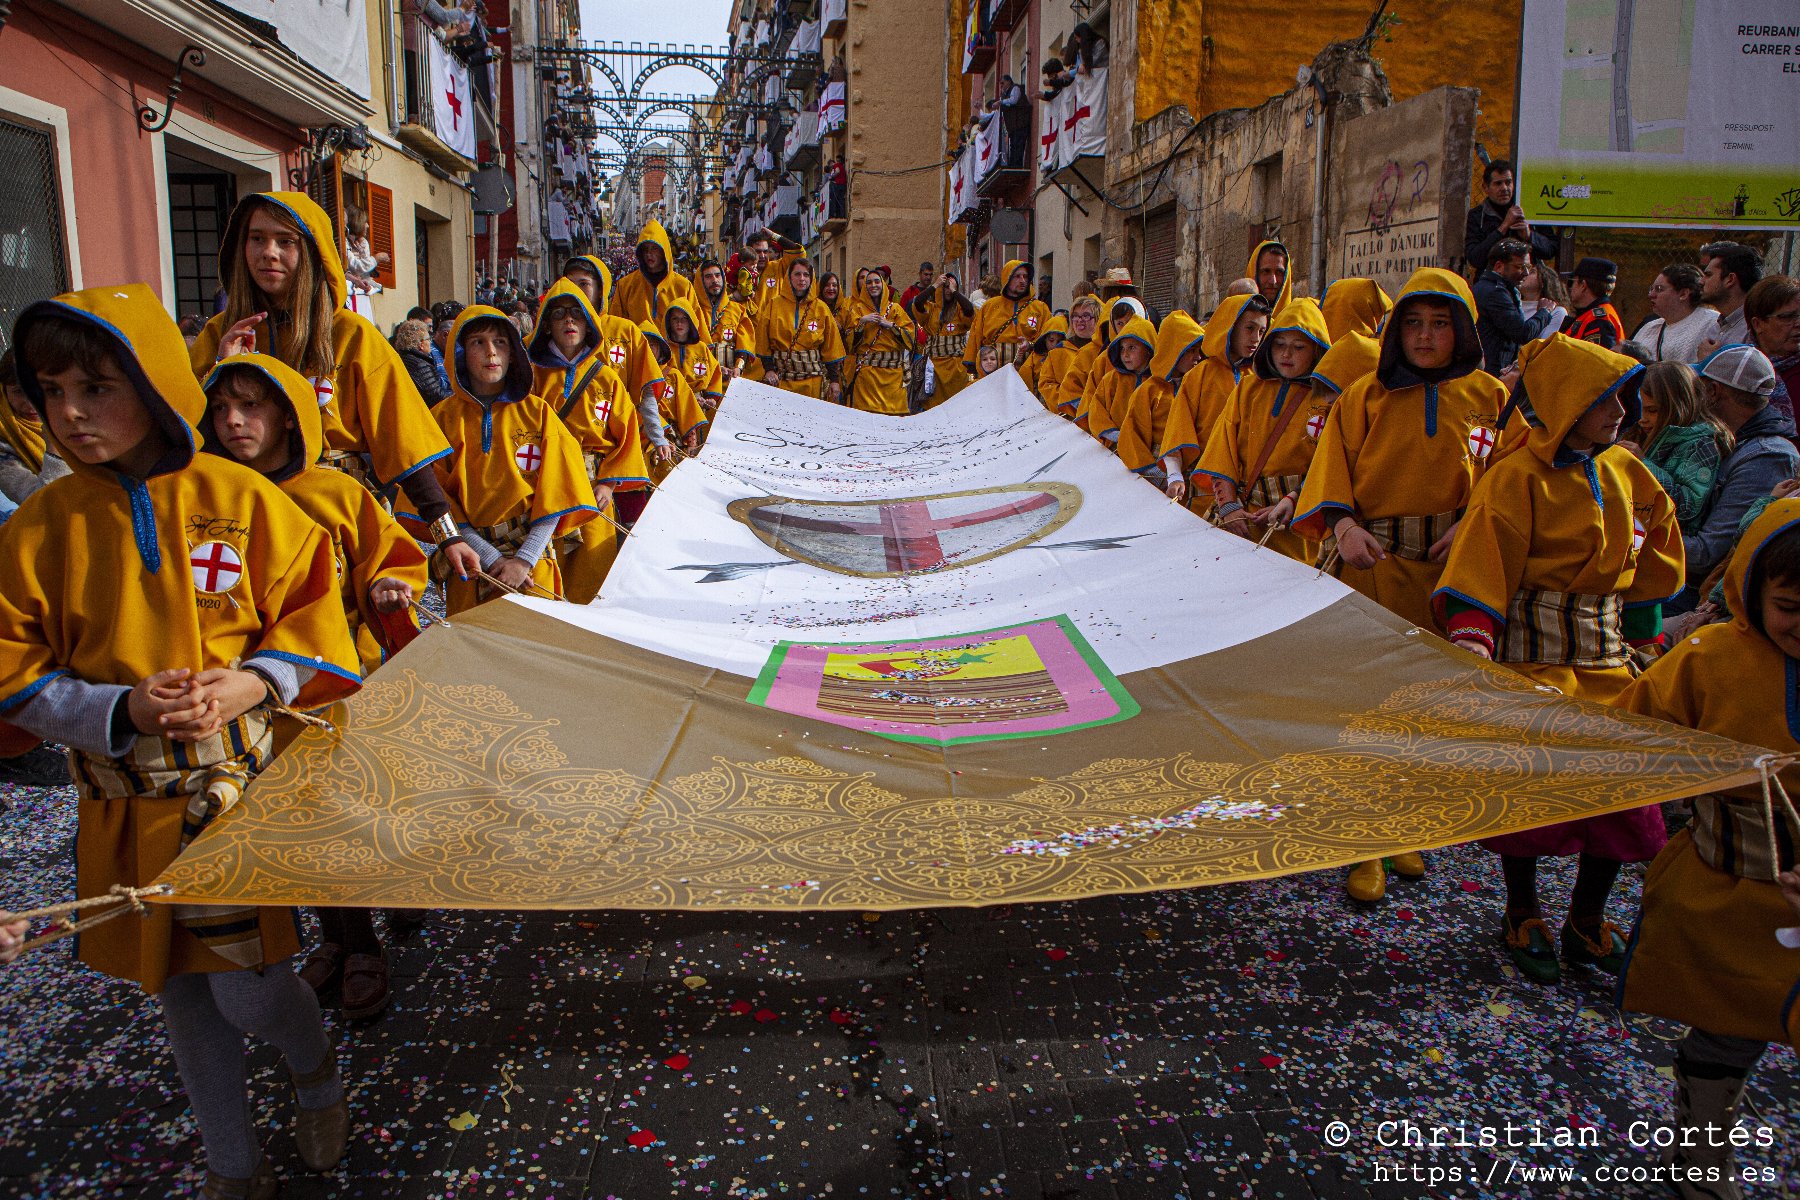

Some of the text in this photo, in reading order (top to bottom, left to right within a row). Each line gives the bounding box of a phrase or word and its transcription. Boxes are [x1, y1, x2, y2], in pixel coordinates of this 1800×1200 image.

[1737, 25, 1800, 37] REURBANI
[1742, 43, 1792, 55] CARRER
[1724, 123, 1776, 133] PRESSUPOST:
[1722, 142, 1754, 151] TERMINI:
[1367, 260, 1381, 276] EL
